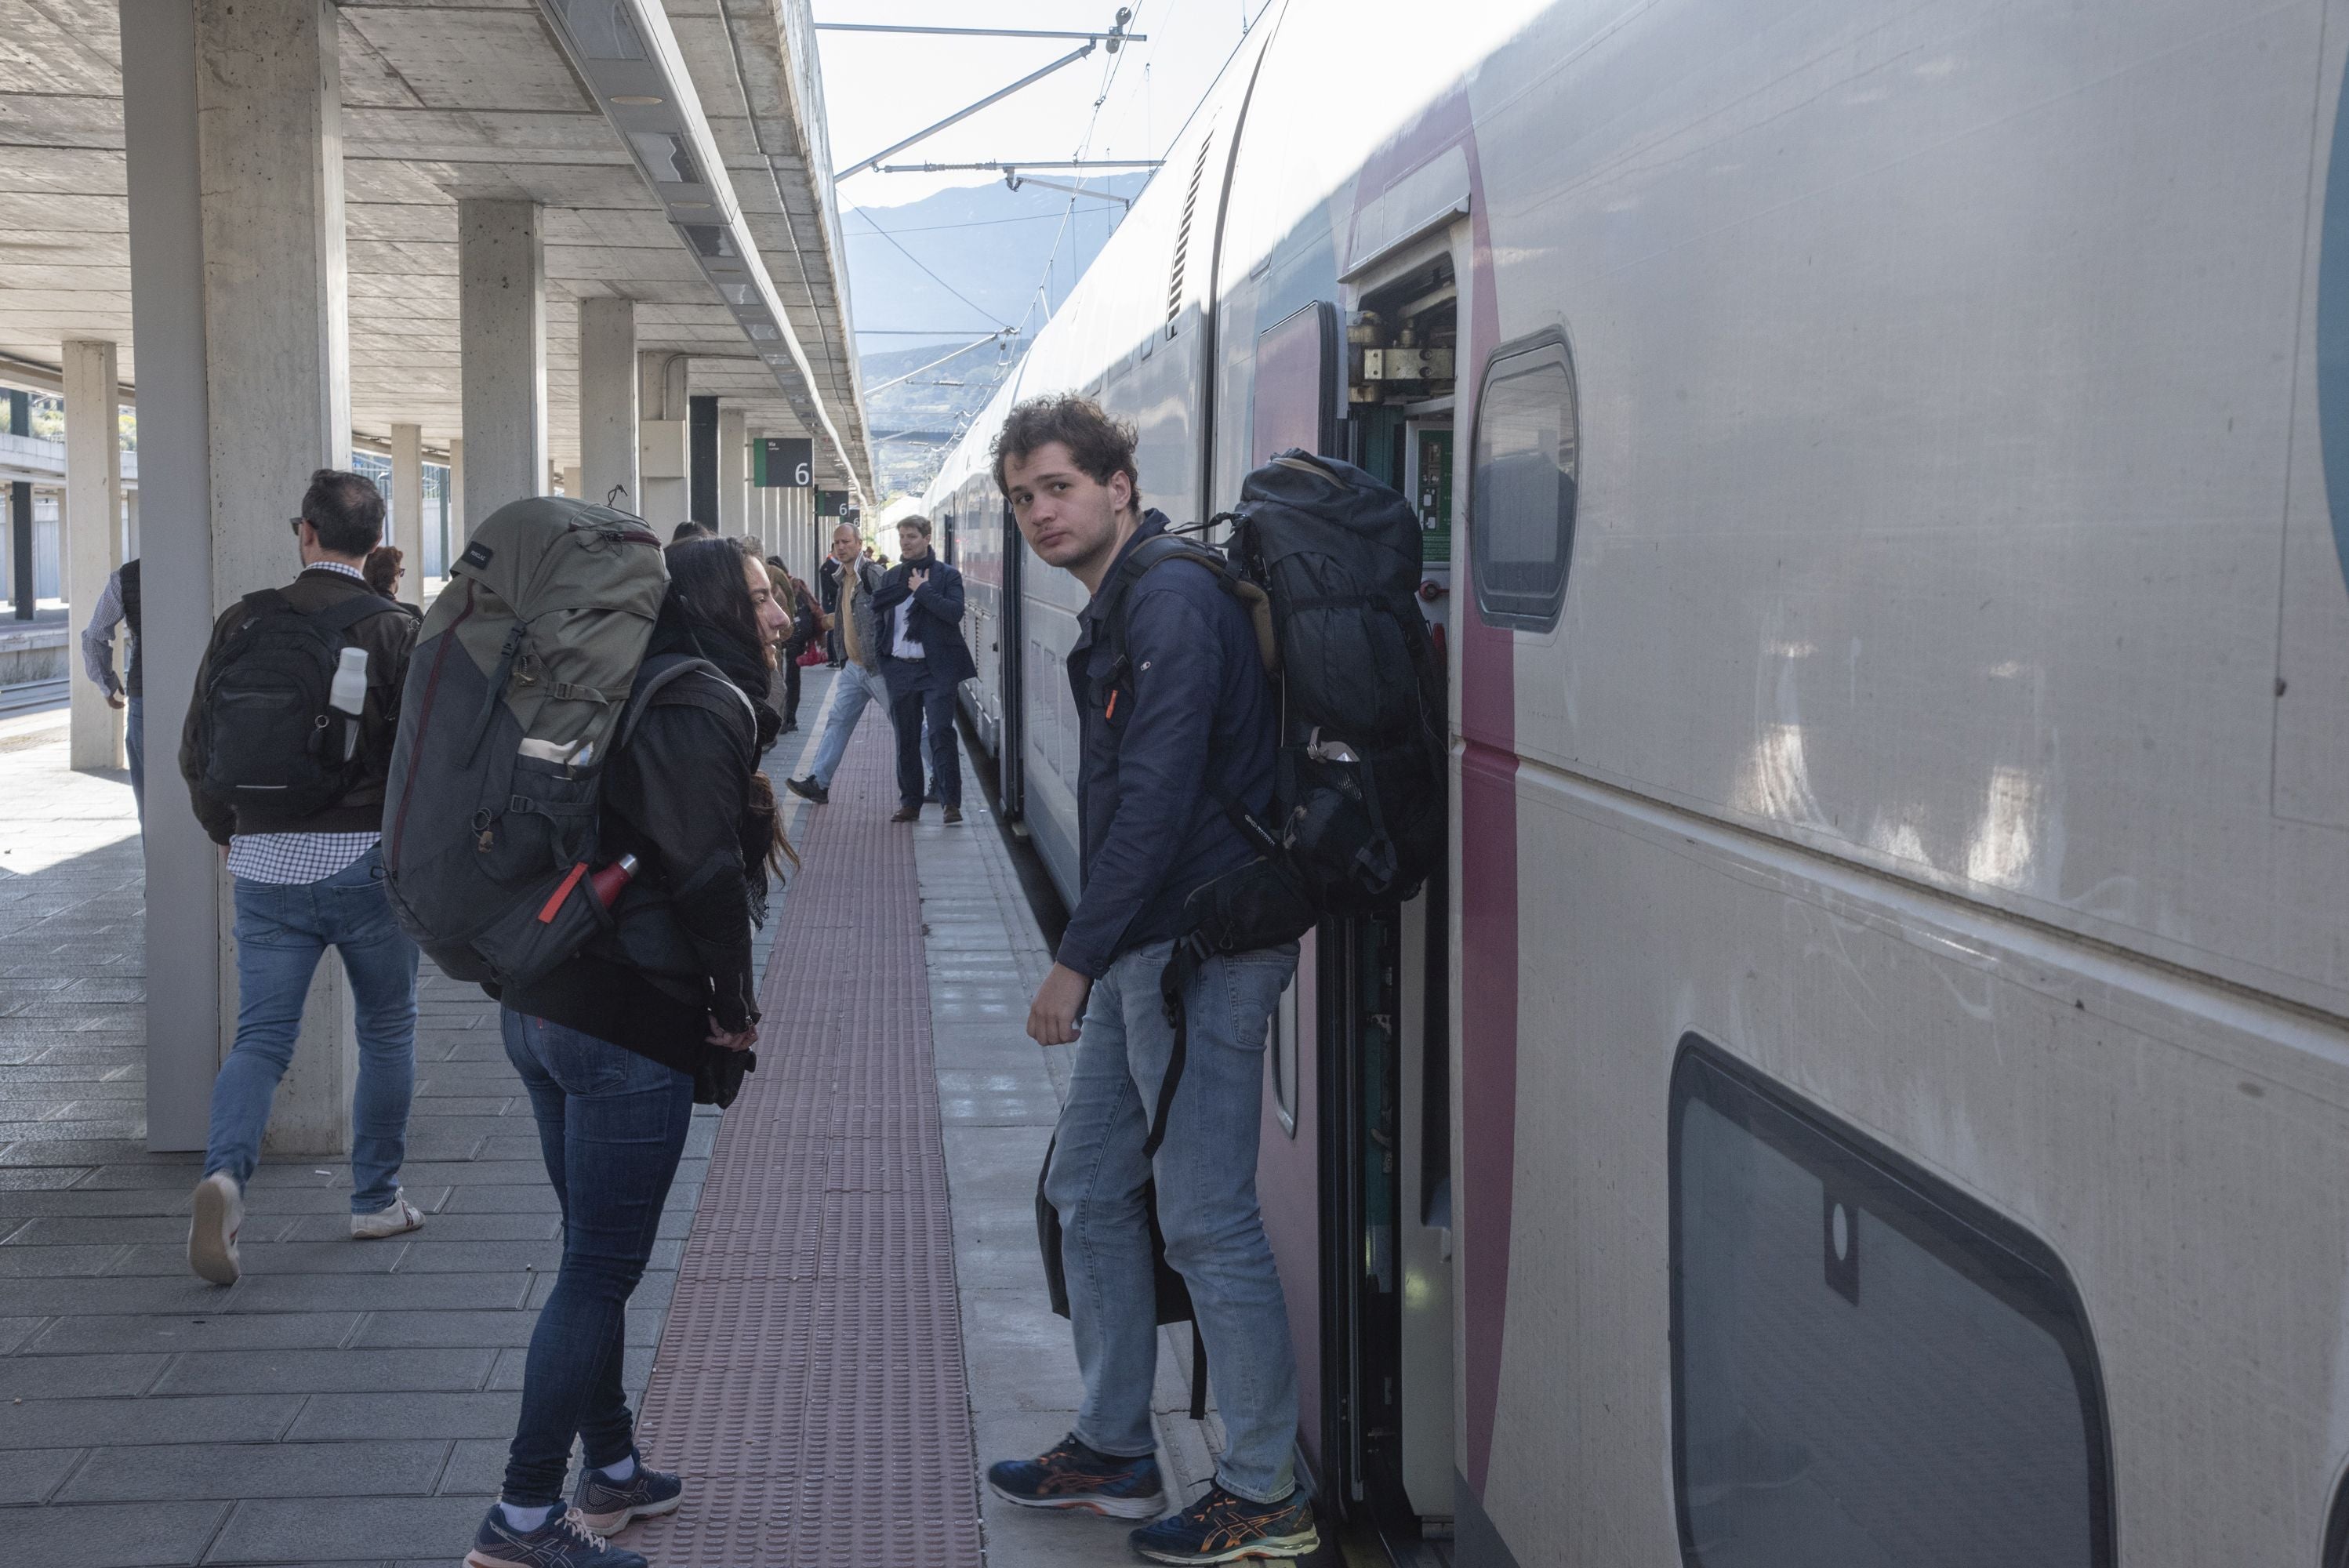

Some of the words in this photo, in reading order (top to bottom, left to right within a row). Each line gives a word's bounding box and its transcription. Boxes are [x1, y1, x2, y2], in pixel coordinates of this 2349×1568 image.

[795, 463, 809, 485] 6
[839, 503, 848, 516] 6
[853, 517, 859, 527] 6
